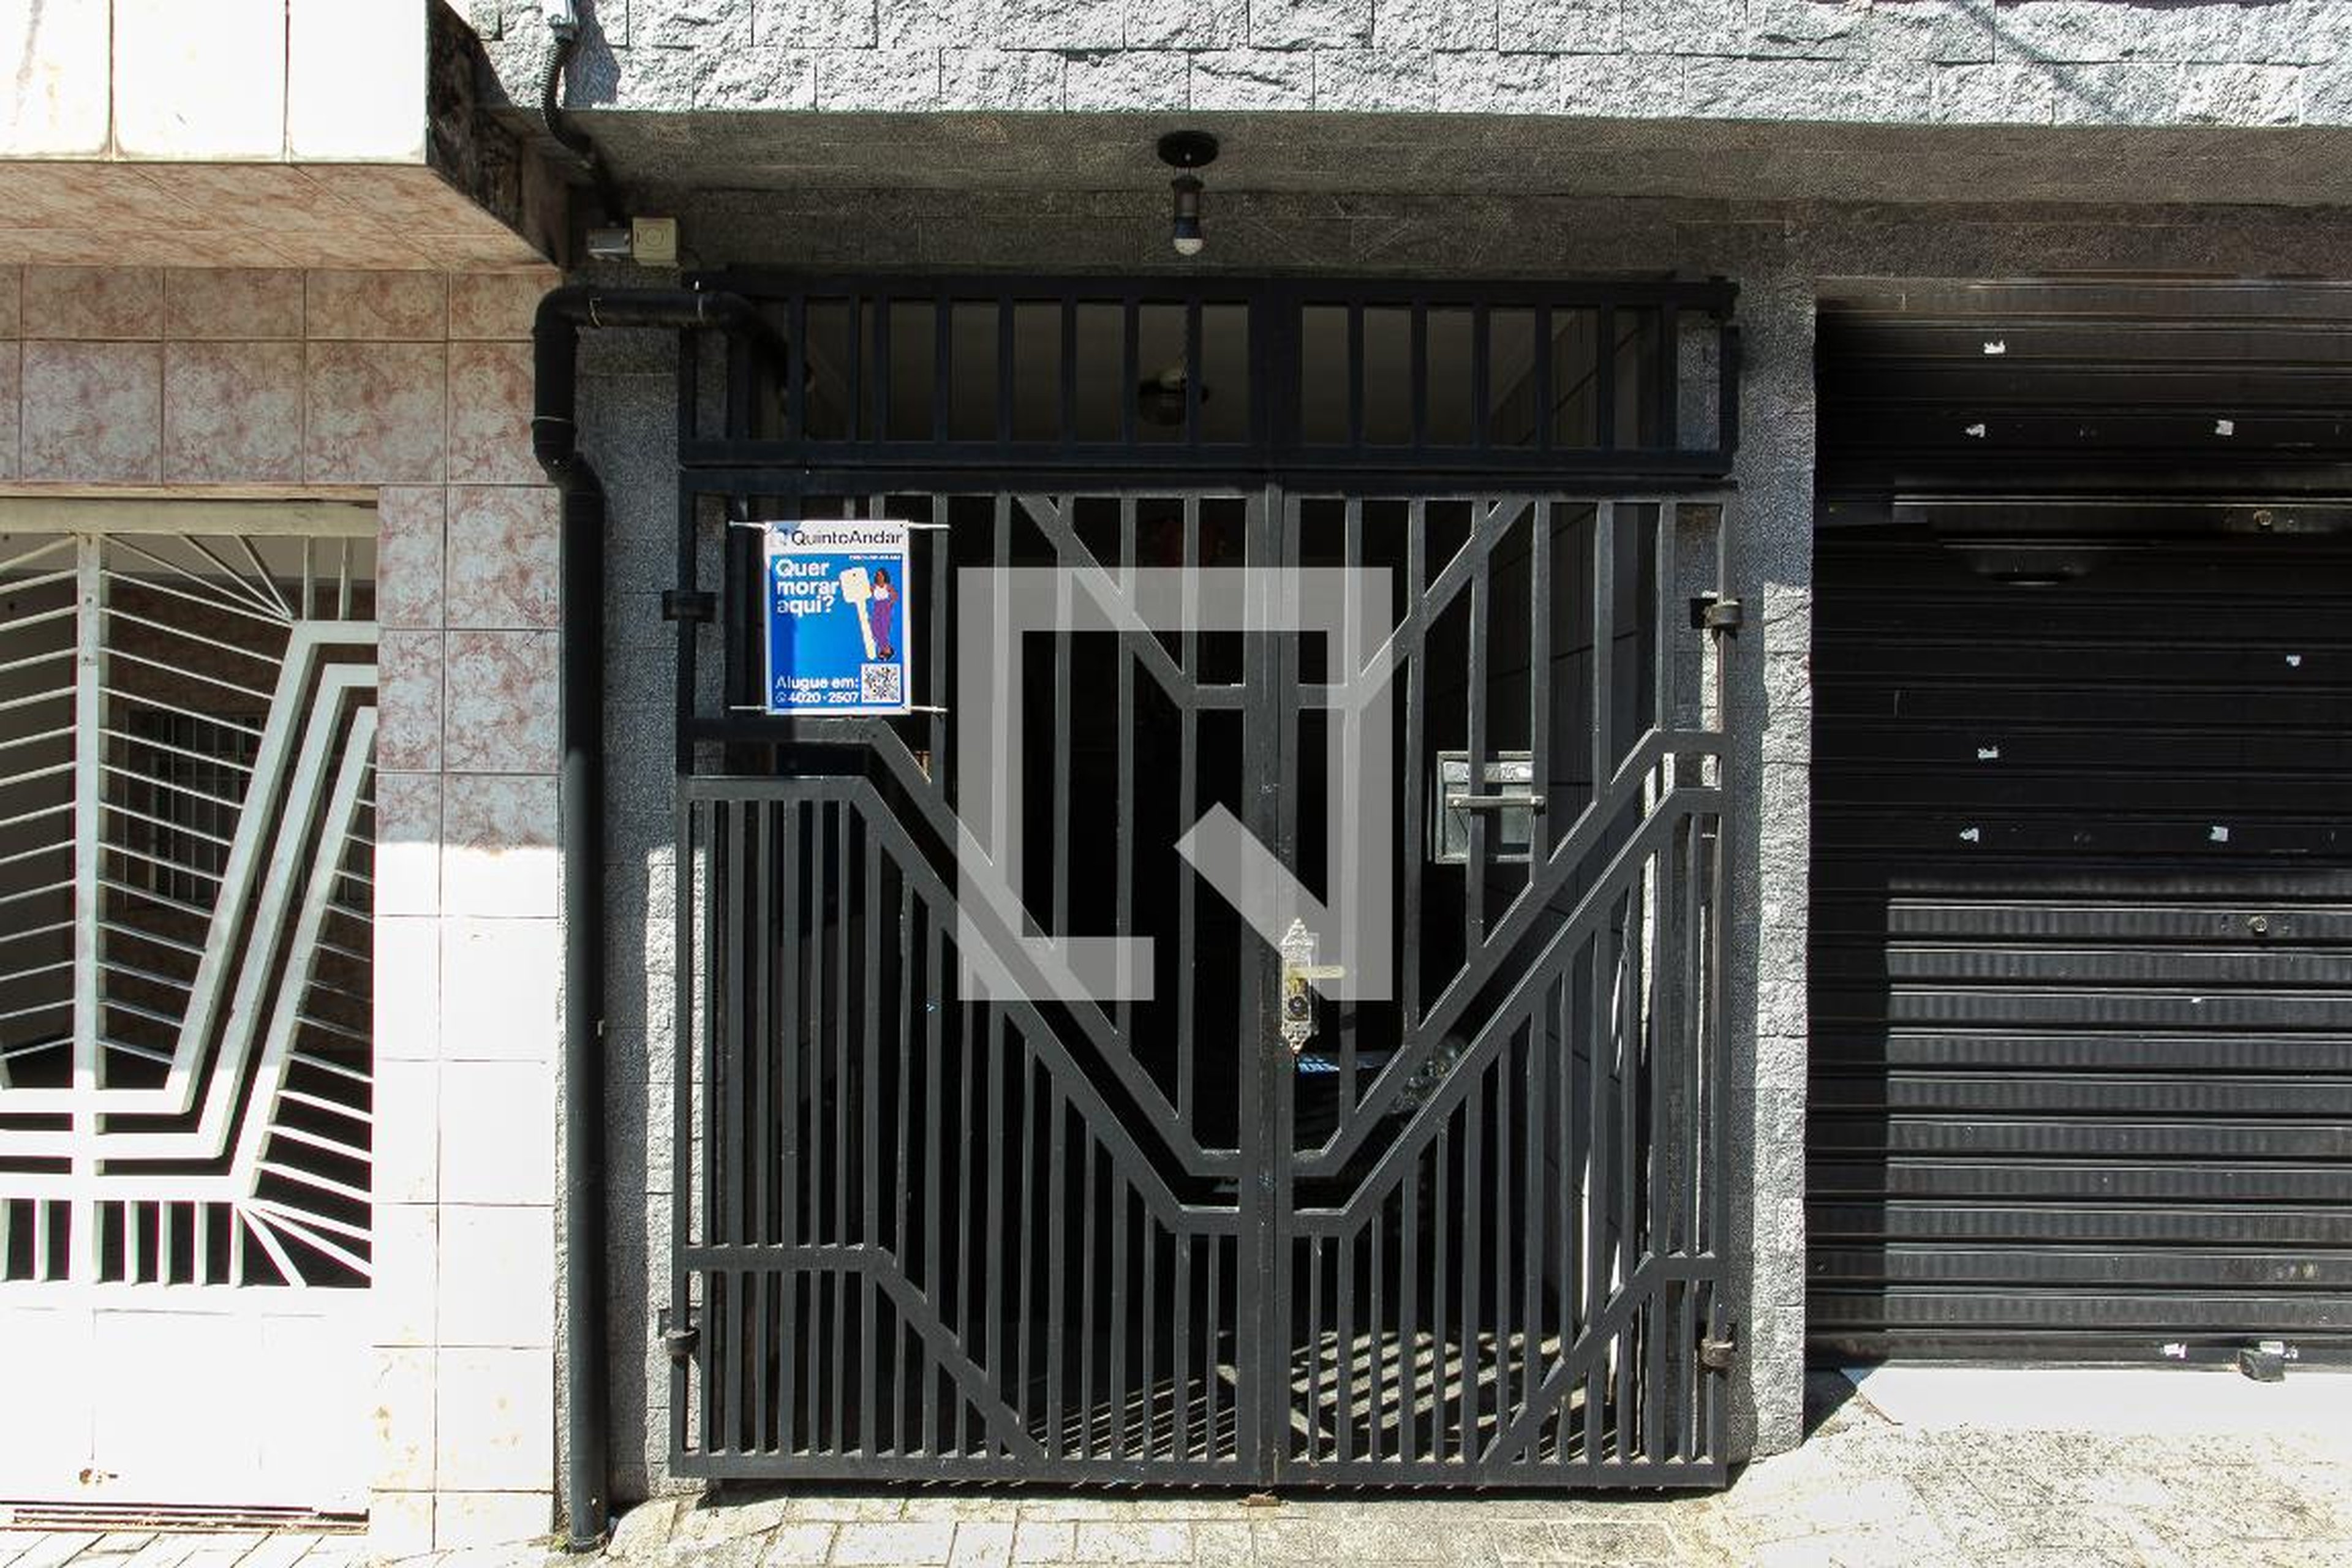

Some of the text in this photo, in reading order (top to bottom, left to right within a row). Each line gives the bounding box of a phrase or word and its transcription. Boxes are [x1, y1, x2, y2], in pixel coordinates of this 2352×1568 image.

[791, 530, 902, 546] QuintoAndar
[775, 559, 829, 578] Quer
[777, 581, 839, 596] morar
[777, 596, 834, 617] aqui?
[775, 676, 859, 692] Alugue em:
